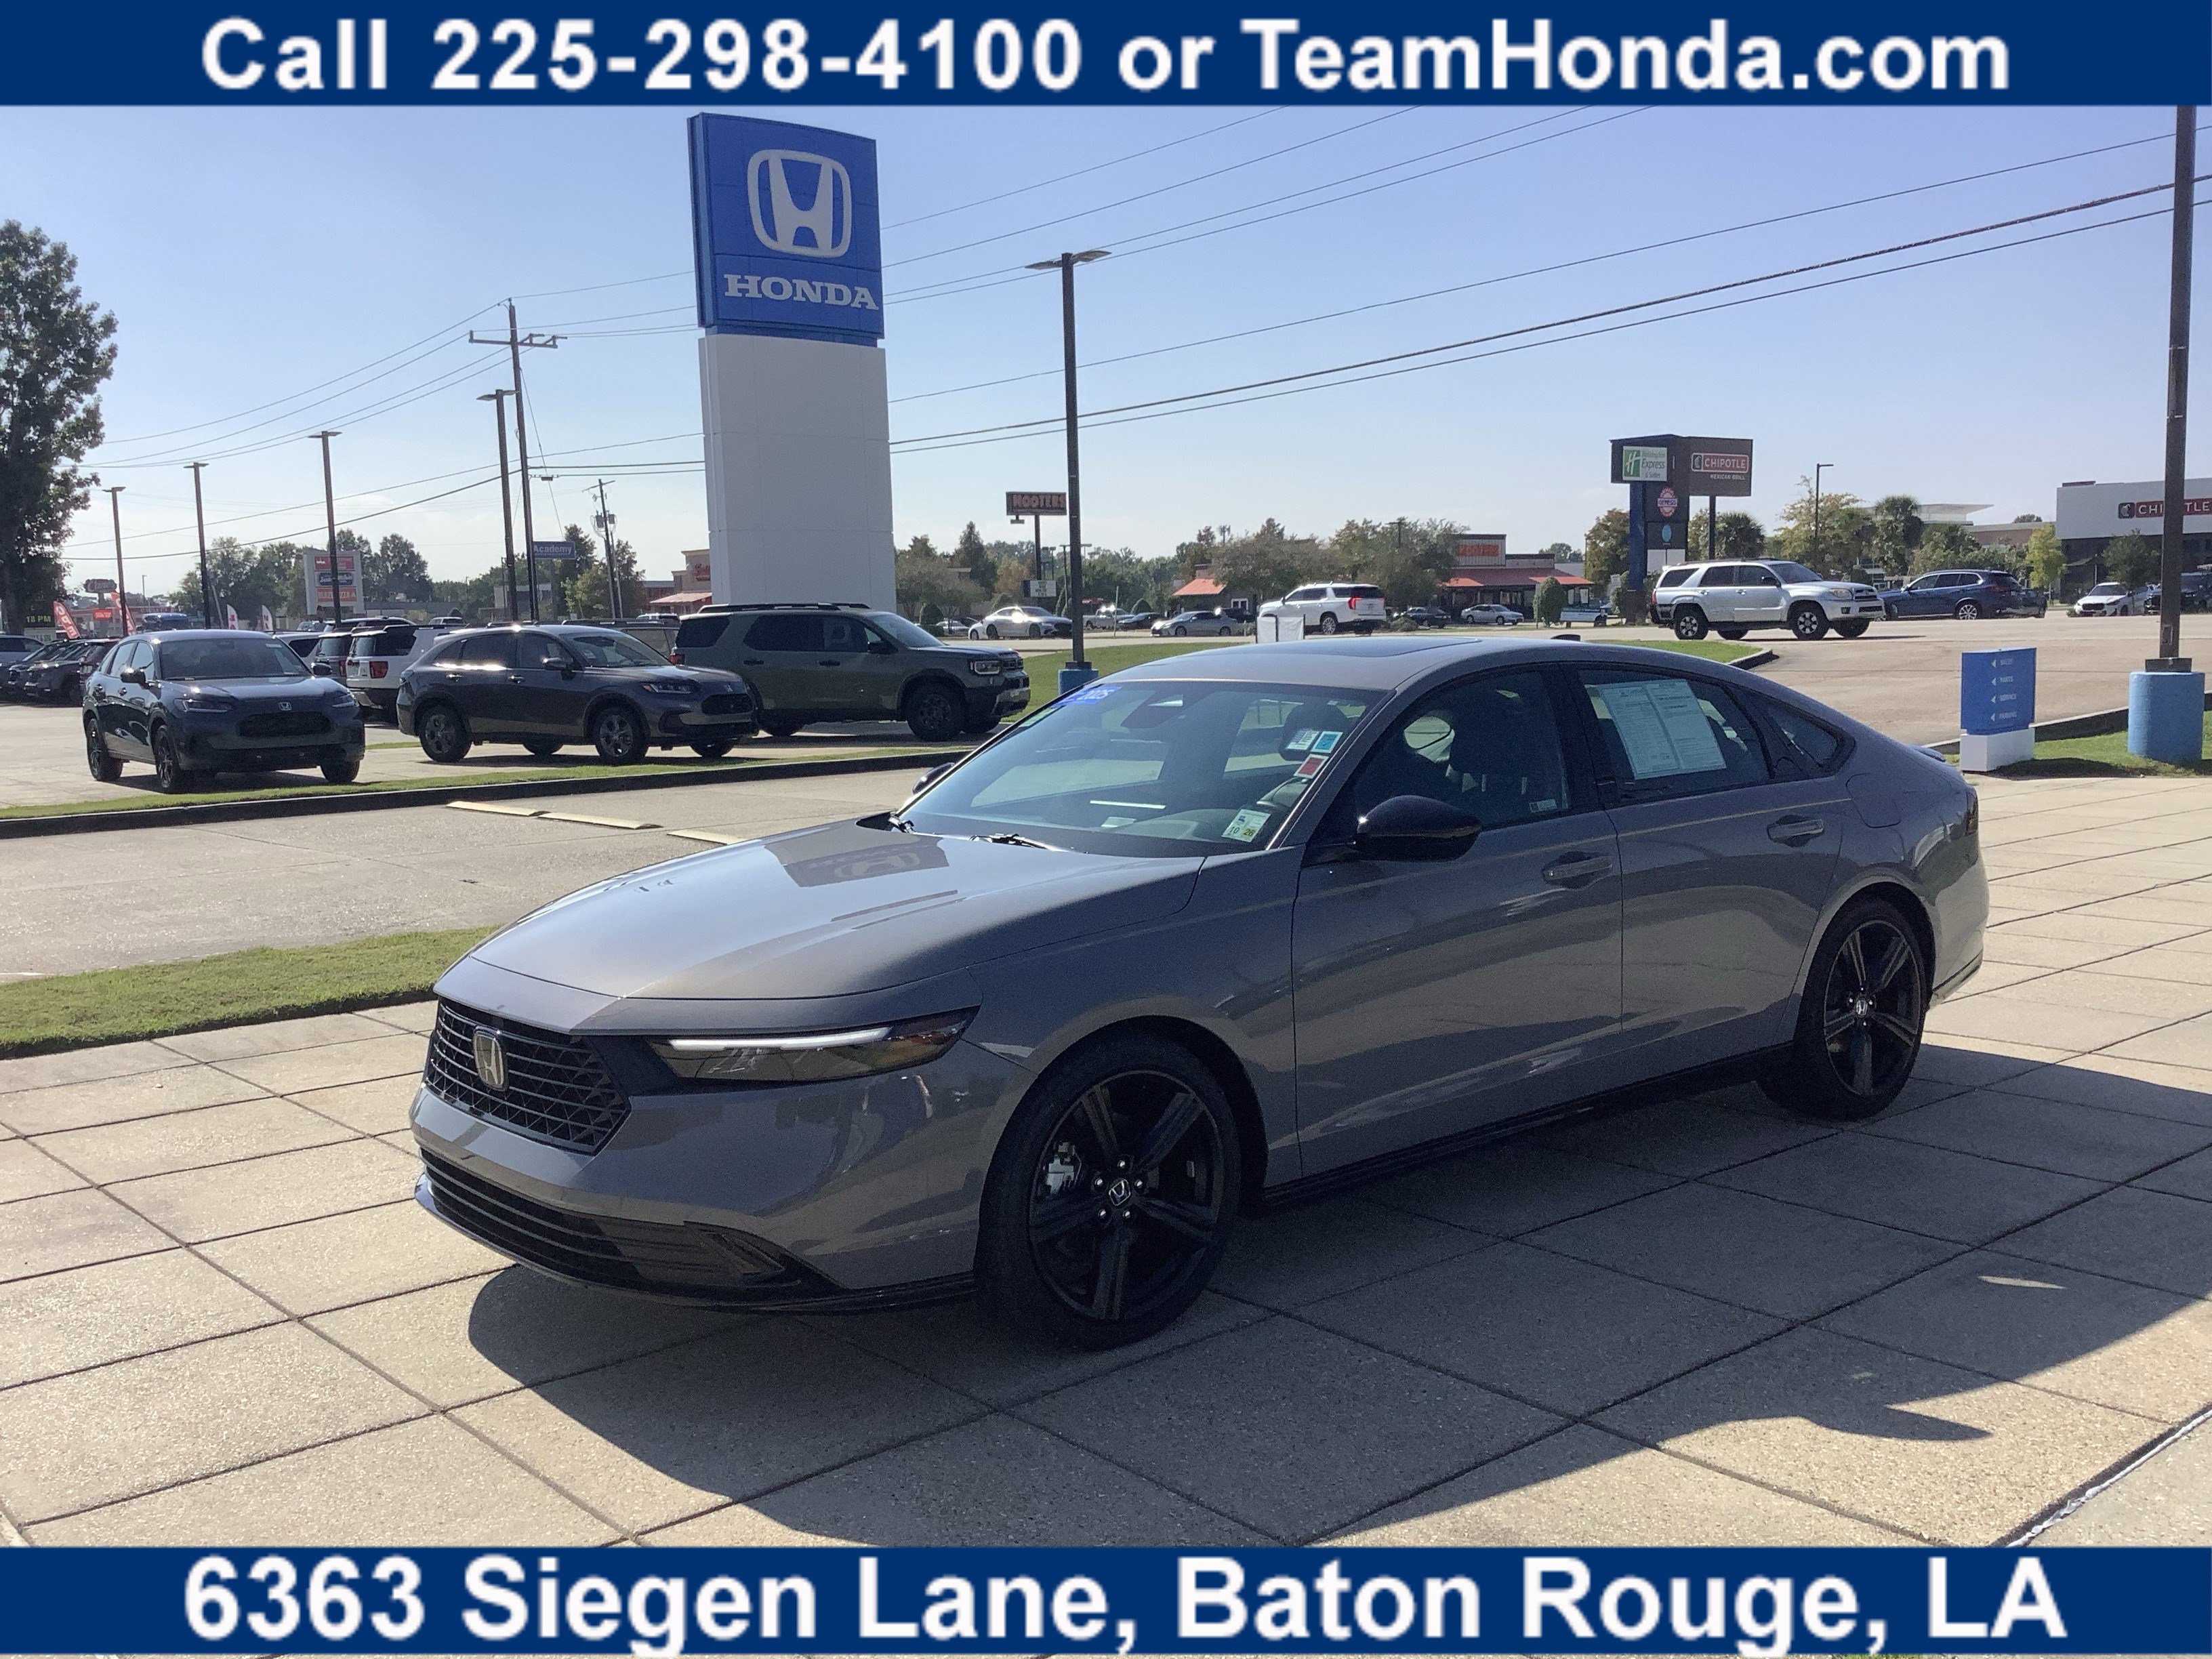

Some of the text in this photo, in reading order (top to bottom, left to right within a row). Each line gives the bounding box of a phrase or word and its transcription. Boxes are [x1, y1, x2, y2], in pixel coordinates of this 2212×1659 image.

[724, 274, 879, 310] HONDA
[1641, 457, 1666, 470] Express
[1704, 457, 1746, 469] CHIPOTLE
[1012, 494, 1065, 508] HOOTERS
[2138, 501, 2210, 514] CHITLE
[533, 544, 573, 554] Academy
